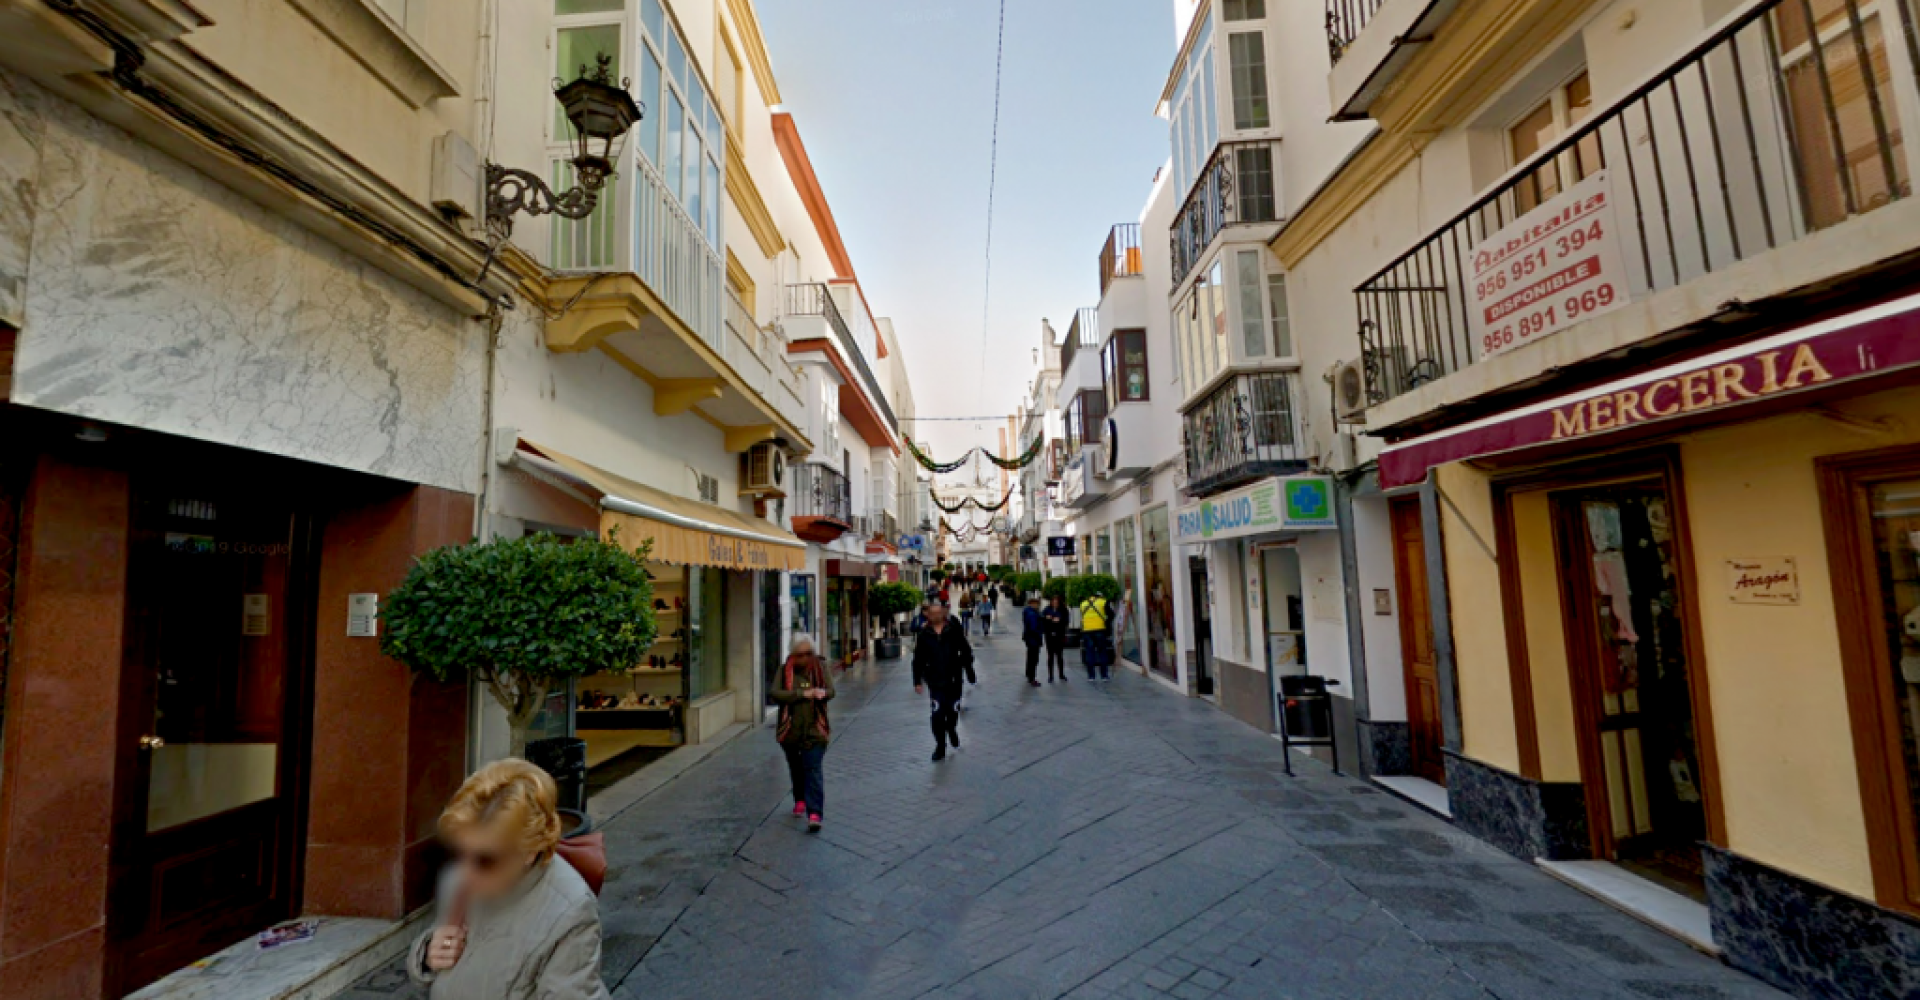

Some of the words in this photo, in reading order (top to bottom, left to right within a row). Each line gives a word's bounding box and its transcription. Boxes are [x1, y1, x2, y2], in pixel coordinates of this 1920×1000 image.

[1477, 270, 1507, 301] 956
[1511, 247, 1547, 281] 951
[1555, 219, 1603, 257] 394
[1490, 264, 1591, 319] DISPONIBLE
[1483, 325, 1514, 353] 956
[1519, 306, 1556, 337] 891
[1565, 283, 1614, 319] 969
[1551, 343, 1832, 437] MERCERIA
[1178, 510, 1202, 537] PARA
[1213, 496, 1251, 531] SALUD
